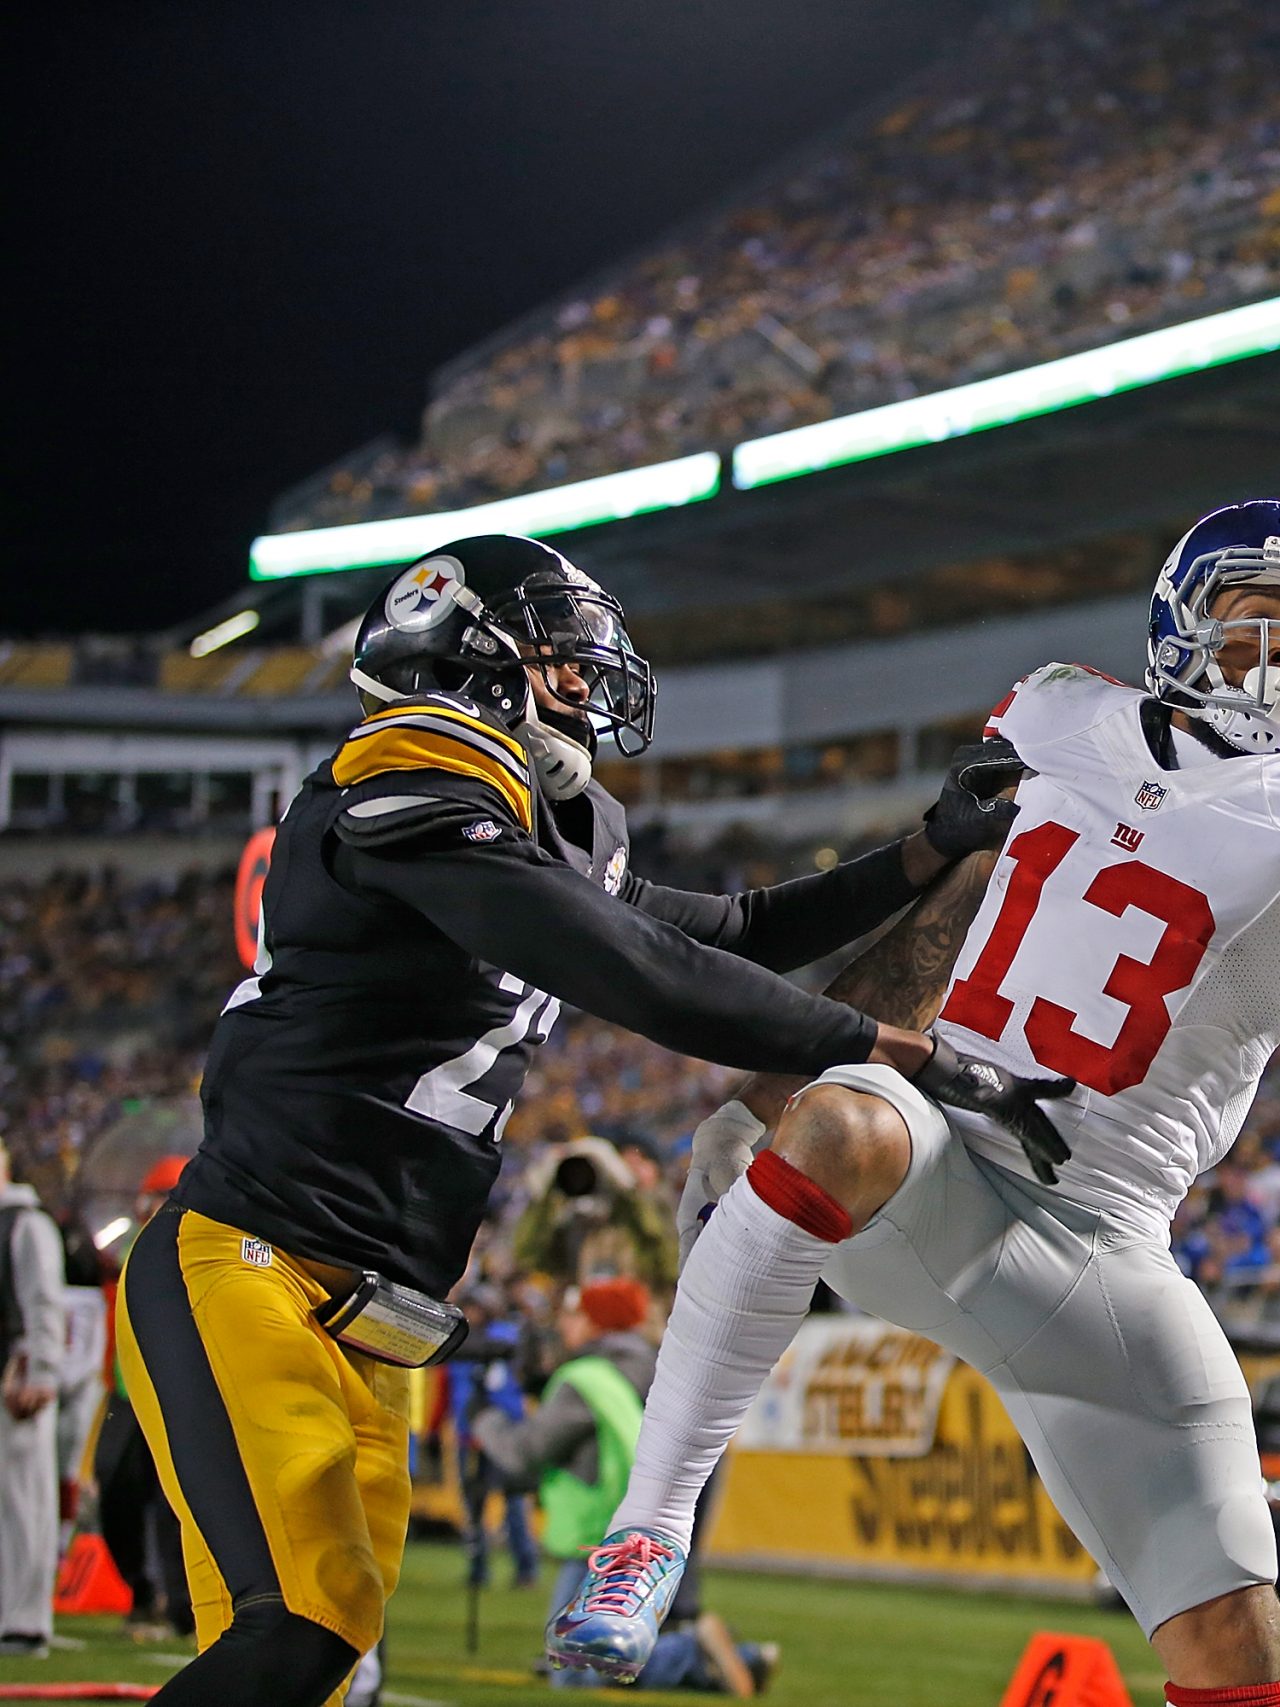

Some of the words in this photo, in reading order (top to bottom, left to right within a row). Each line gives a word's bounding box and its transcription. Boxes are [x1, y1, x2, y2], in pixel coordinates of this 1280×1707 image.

[394, 589, 418, 606] Steelers
[1138, 791, 1158, 808] NFL
[939, 821, 1216, 1096] 13
[404, 971, 561, 1142] 2
[247, 1250, 267, 1263] NFL
